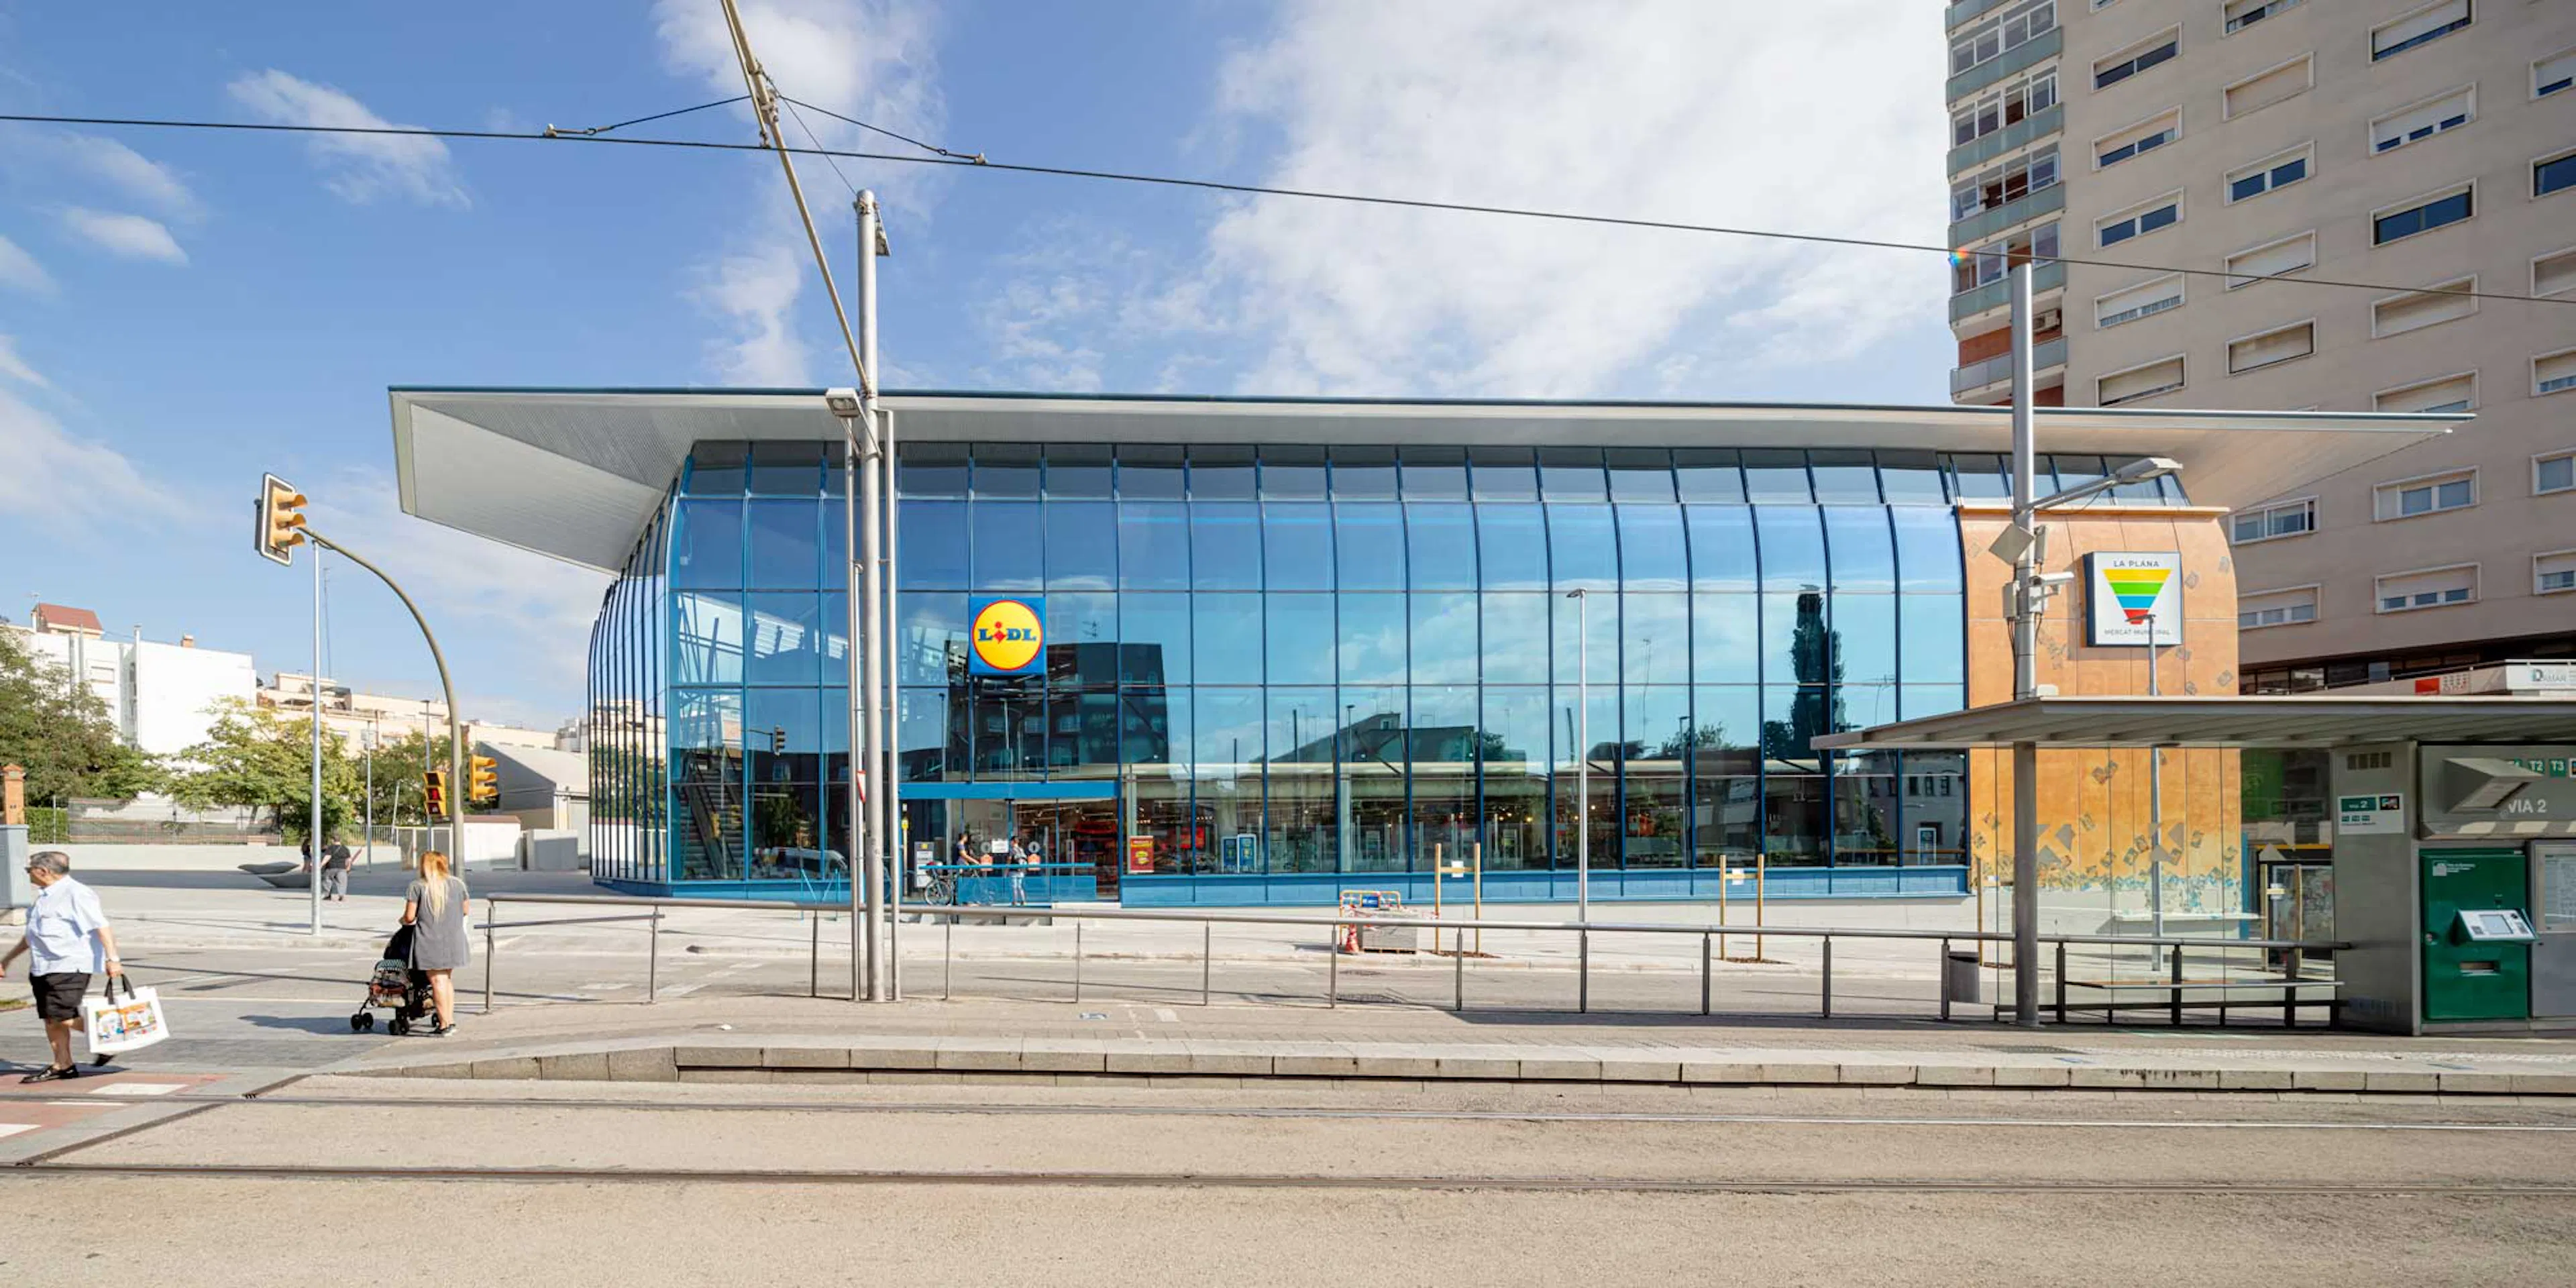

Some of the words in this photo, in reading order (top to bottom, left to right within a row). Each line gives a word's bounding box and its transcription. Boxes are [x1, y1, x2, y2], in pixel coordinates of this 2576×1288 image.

[2530, 761, 2543, 771] T2
[2551, 761, 2565, 771] T3
[2509, 800, 2533, 813] VIA
[2537, 799, 2547, 813] 2
